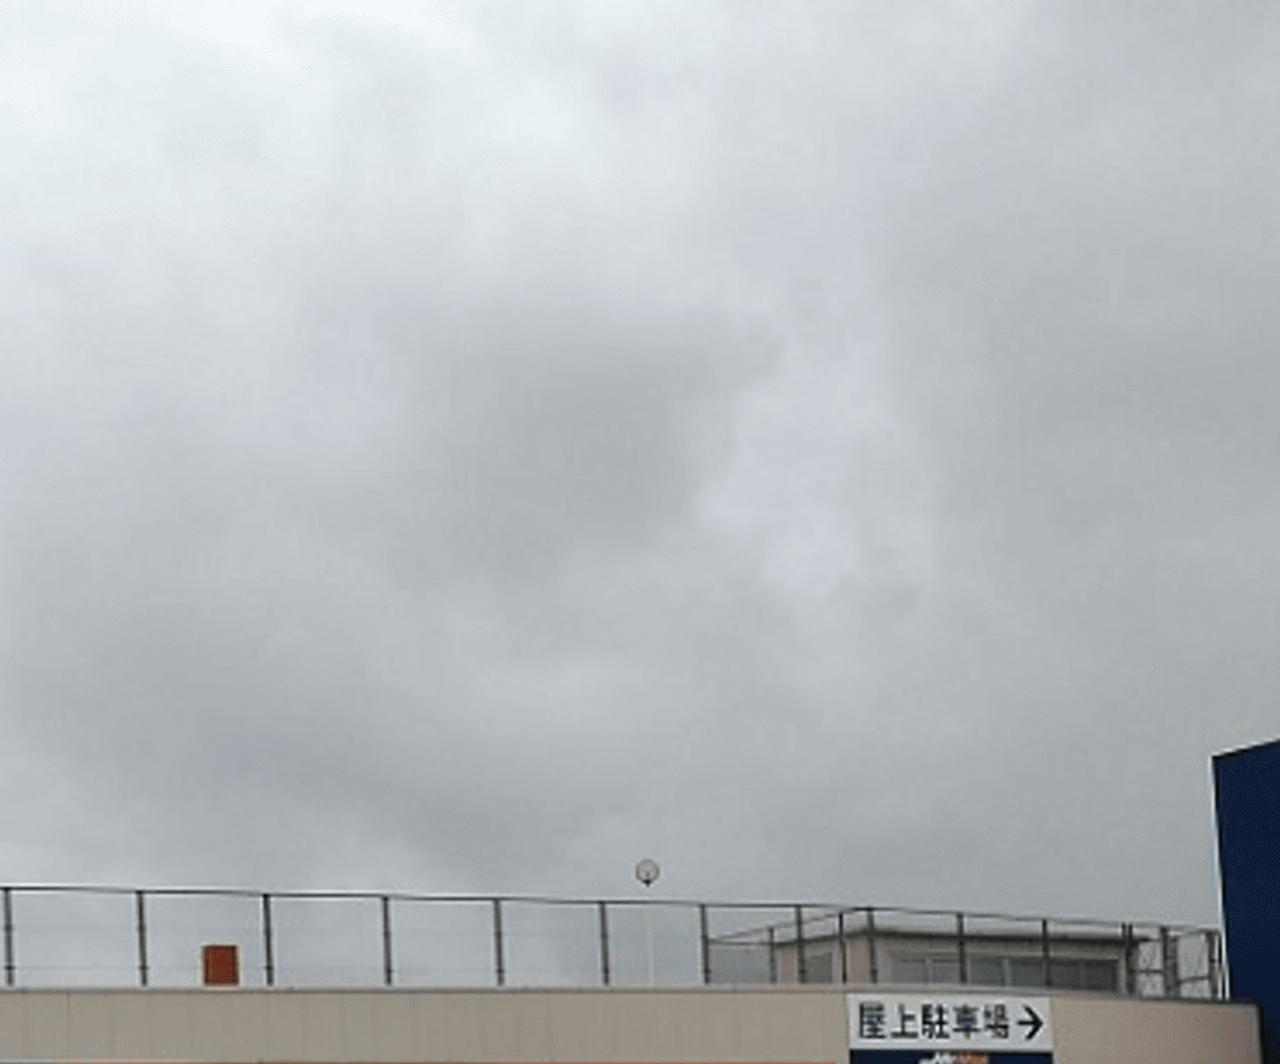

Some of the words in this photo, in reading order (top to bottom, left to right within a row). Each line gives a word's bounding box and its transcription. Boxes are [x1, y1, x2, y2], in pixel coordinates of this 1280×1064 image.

[858, 1002, 1009, 1040] 屋上駐車場
